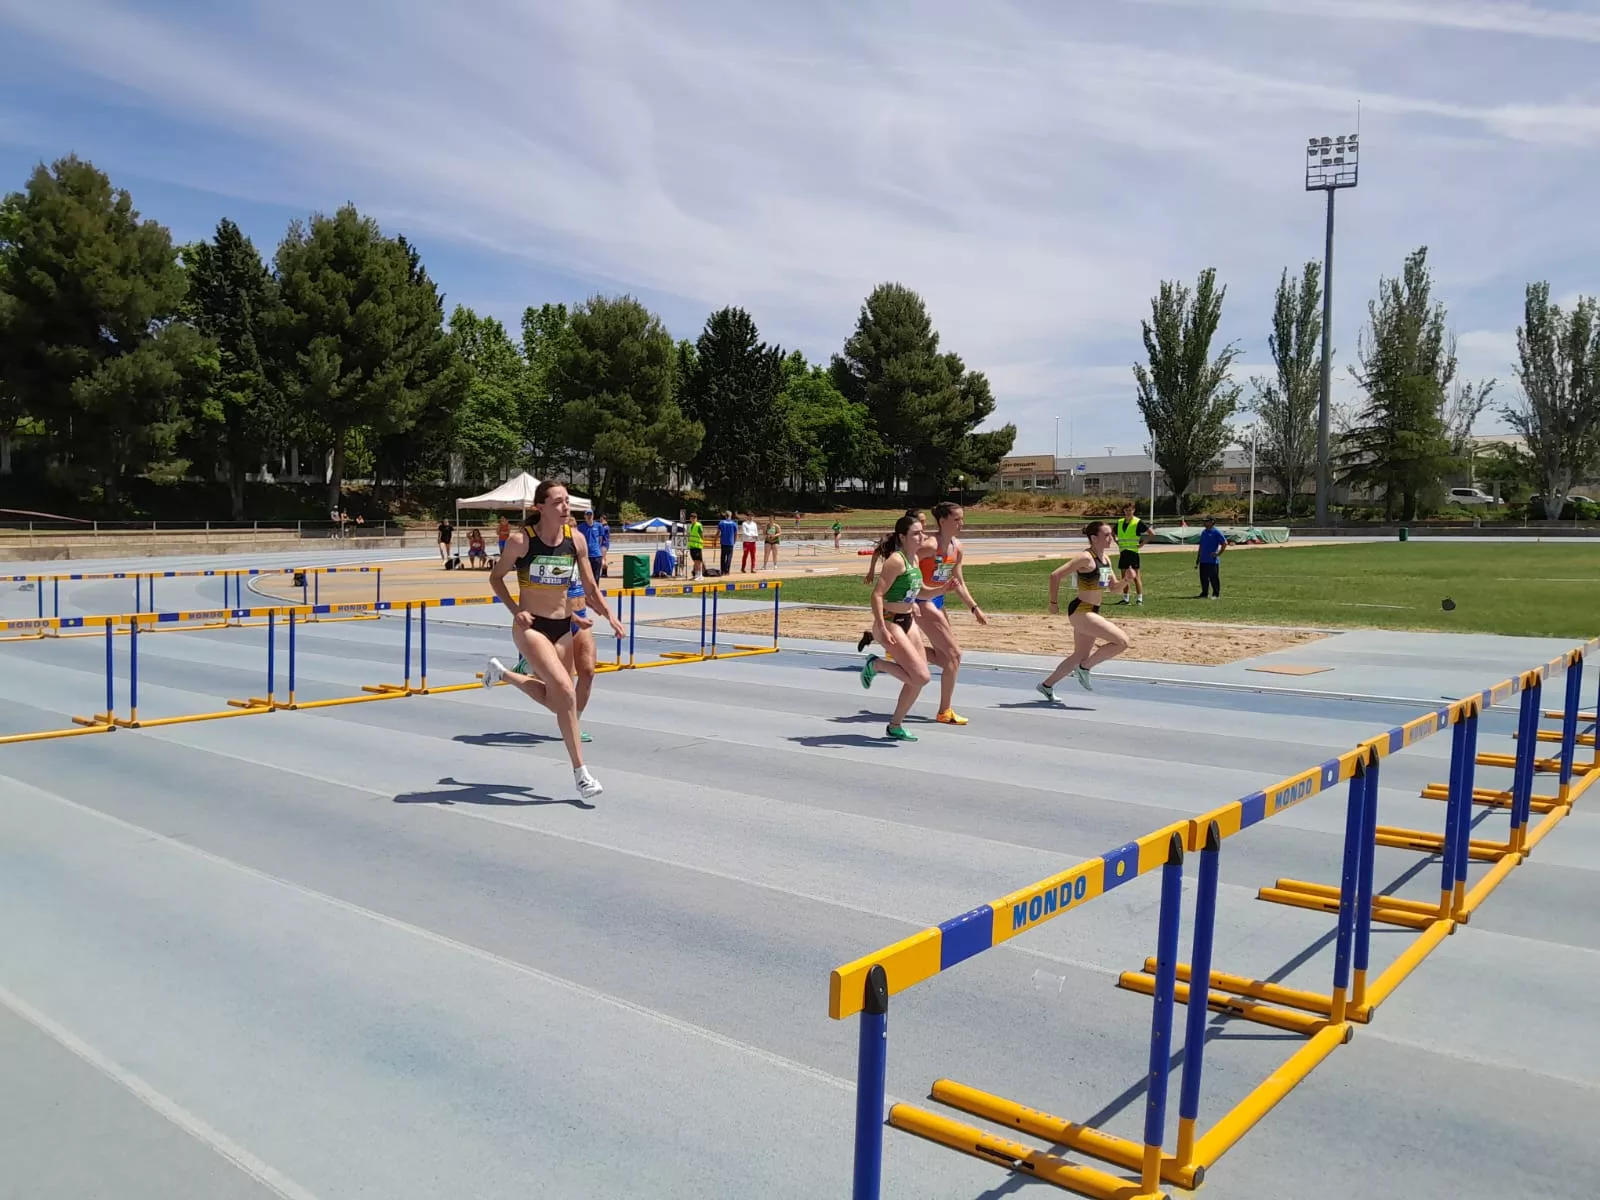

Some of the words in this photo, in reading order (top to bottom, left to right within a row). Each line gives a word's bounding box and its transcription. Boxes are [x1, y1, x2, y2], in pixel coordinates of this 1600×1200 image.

[539, 565, 545, 576] 8
[1274, 778, 1312, 809] MONDO
[1012, 875, 1086, 930] MONDO
